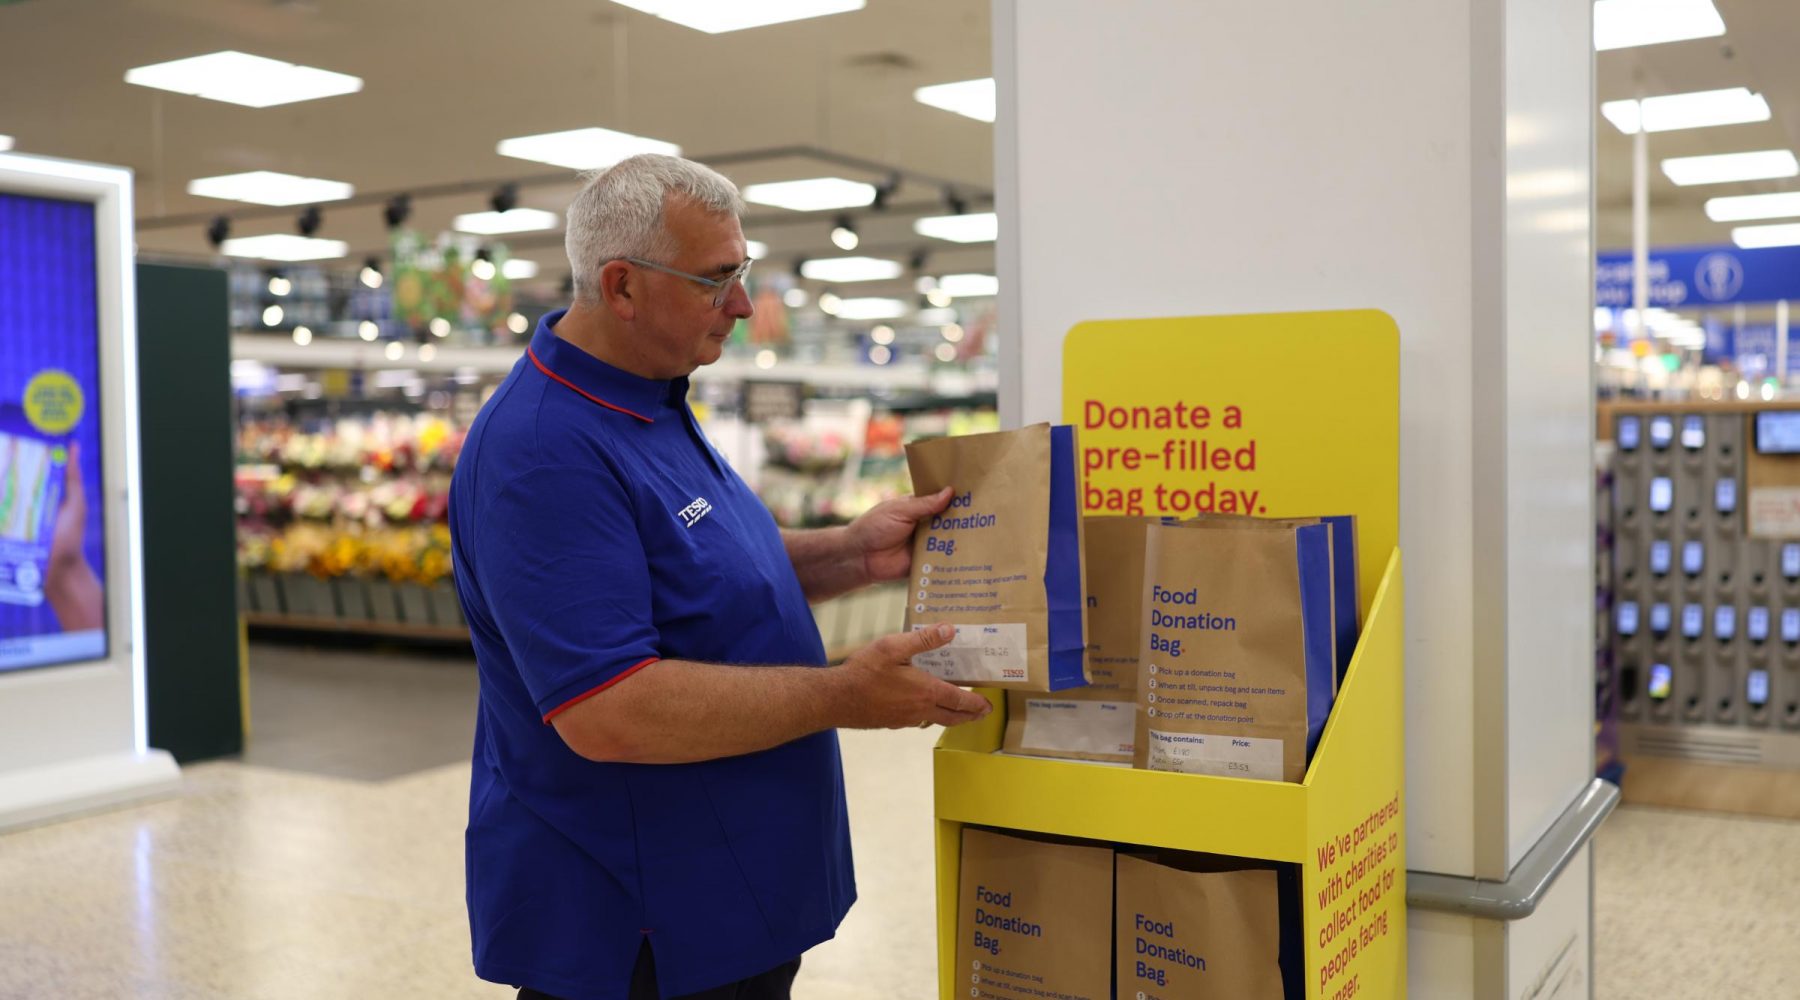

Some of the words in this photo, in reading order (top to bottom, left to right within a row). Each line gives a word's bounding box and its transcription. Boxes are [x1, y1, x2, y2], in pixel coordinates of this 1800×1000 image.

[1083, 399, 1211, 430] Donate
[1222, 404, 1242, 430] a
[1083, 439, 1256, 478] pre-filled
[1083, 481, 1144, 516] bag
[1154, 482, 1267, 515] today.
[930, 513, 997, 531] Donation
[926, 536, 957, 557] Bag.
[1153, 585, 1197, 605] Food
[1152, 609, 1236, 631] Donation
[1150, 633, 1186, 657] Bag.
[1158, 666, 1173, 676] Pick
[1174, 668, 1184, 678] up
[1190, 669, 1222, 679] donation
[1223, 671, 1236, 680] bag
[1158, 682, 1177, 690] When
[1199, 685, 1224, 694] unpack
[1224, 685, 1237, 695] bag
[1237, 686, 1250, 695] and
[1251, 688, 1267, 696] scan
[1268, 687, 1285, 696] items
[1157, 696, 1176, 704] Once
[1210, 700, 1233, 709] repack
[1234, 701, 1247, 710] bag
[1157, 710, 1173, 720] Drop
[1174, 711, 1184, 719] off
[1185, 712, 1193, 720] at
[1194, 712, 1206, 721] the
[1206, 713, 1237, 723] donation
[1237, 715, 1254, 724] point
[1160, 734, 1172, 743] bag
[1173, 735, 1205, 745] contains:
[1232, 739, 1251, 748] Price:
[1317, 833, 1351, 873] We've
[1353, 791, 1399, 854] partnered
[1318, 873, 1342, 911] with
[1345, 841, 1387, 890] charities
[1388, 831, 1398, 851] to
[976, 885, 1012, 908] Food
[1319, 898, 1357, 949] collect
[1359, 874, 1381, 917] food
[1382, 867, 1395, 892] for
[975, 908, 1042, 938] Donation
[1135, 913, 1174, 938] Food
[1136, 937, 1206, 971] Donation
[1320, 937, 1357, 994] people
[1359, 909, 1388, 953] facing
[1136, 960, 1169, 987] Bag.
